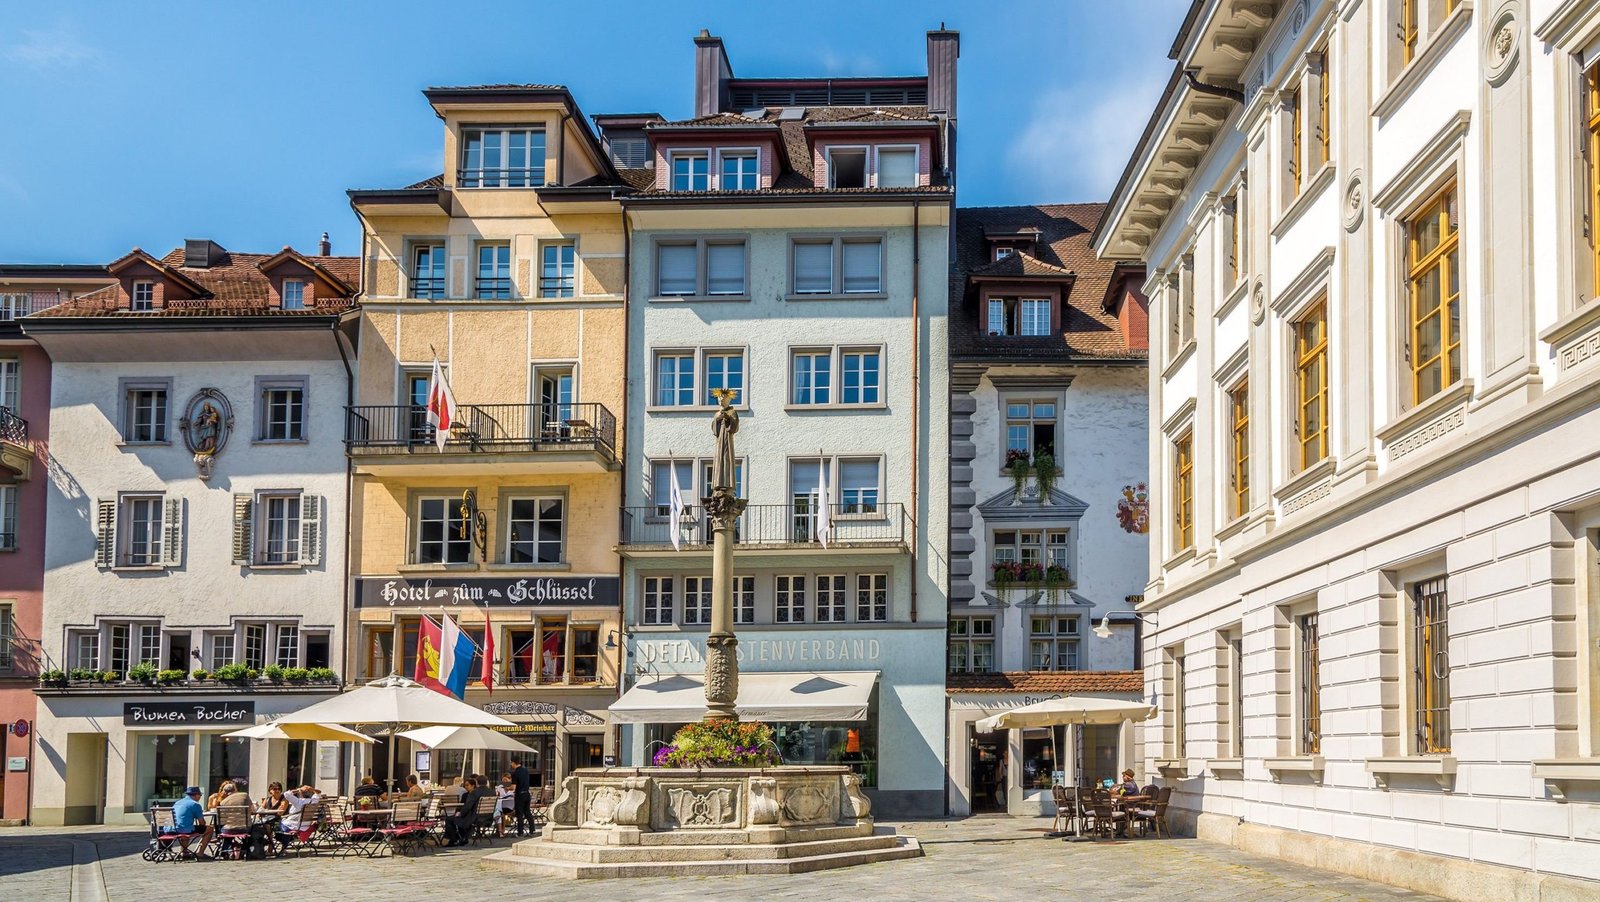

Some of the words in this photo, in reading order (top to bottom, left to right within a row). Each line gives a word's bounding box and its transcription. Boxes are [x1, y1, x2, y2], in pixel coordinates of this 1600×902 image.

[380, 578, 432, 606] Hotel
[506, 577, 597, 606] Schlüssel
[645, 639, 880, 664] DETAISTENVERBAND
[130, 706, 186, 721] Blumen
[193, 702, 247, 720] Bucher
